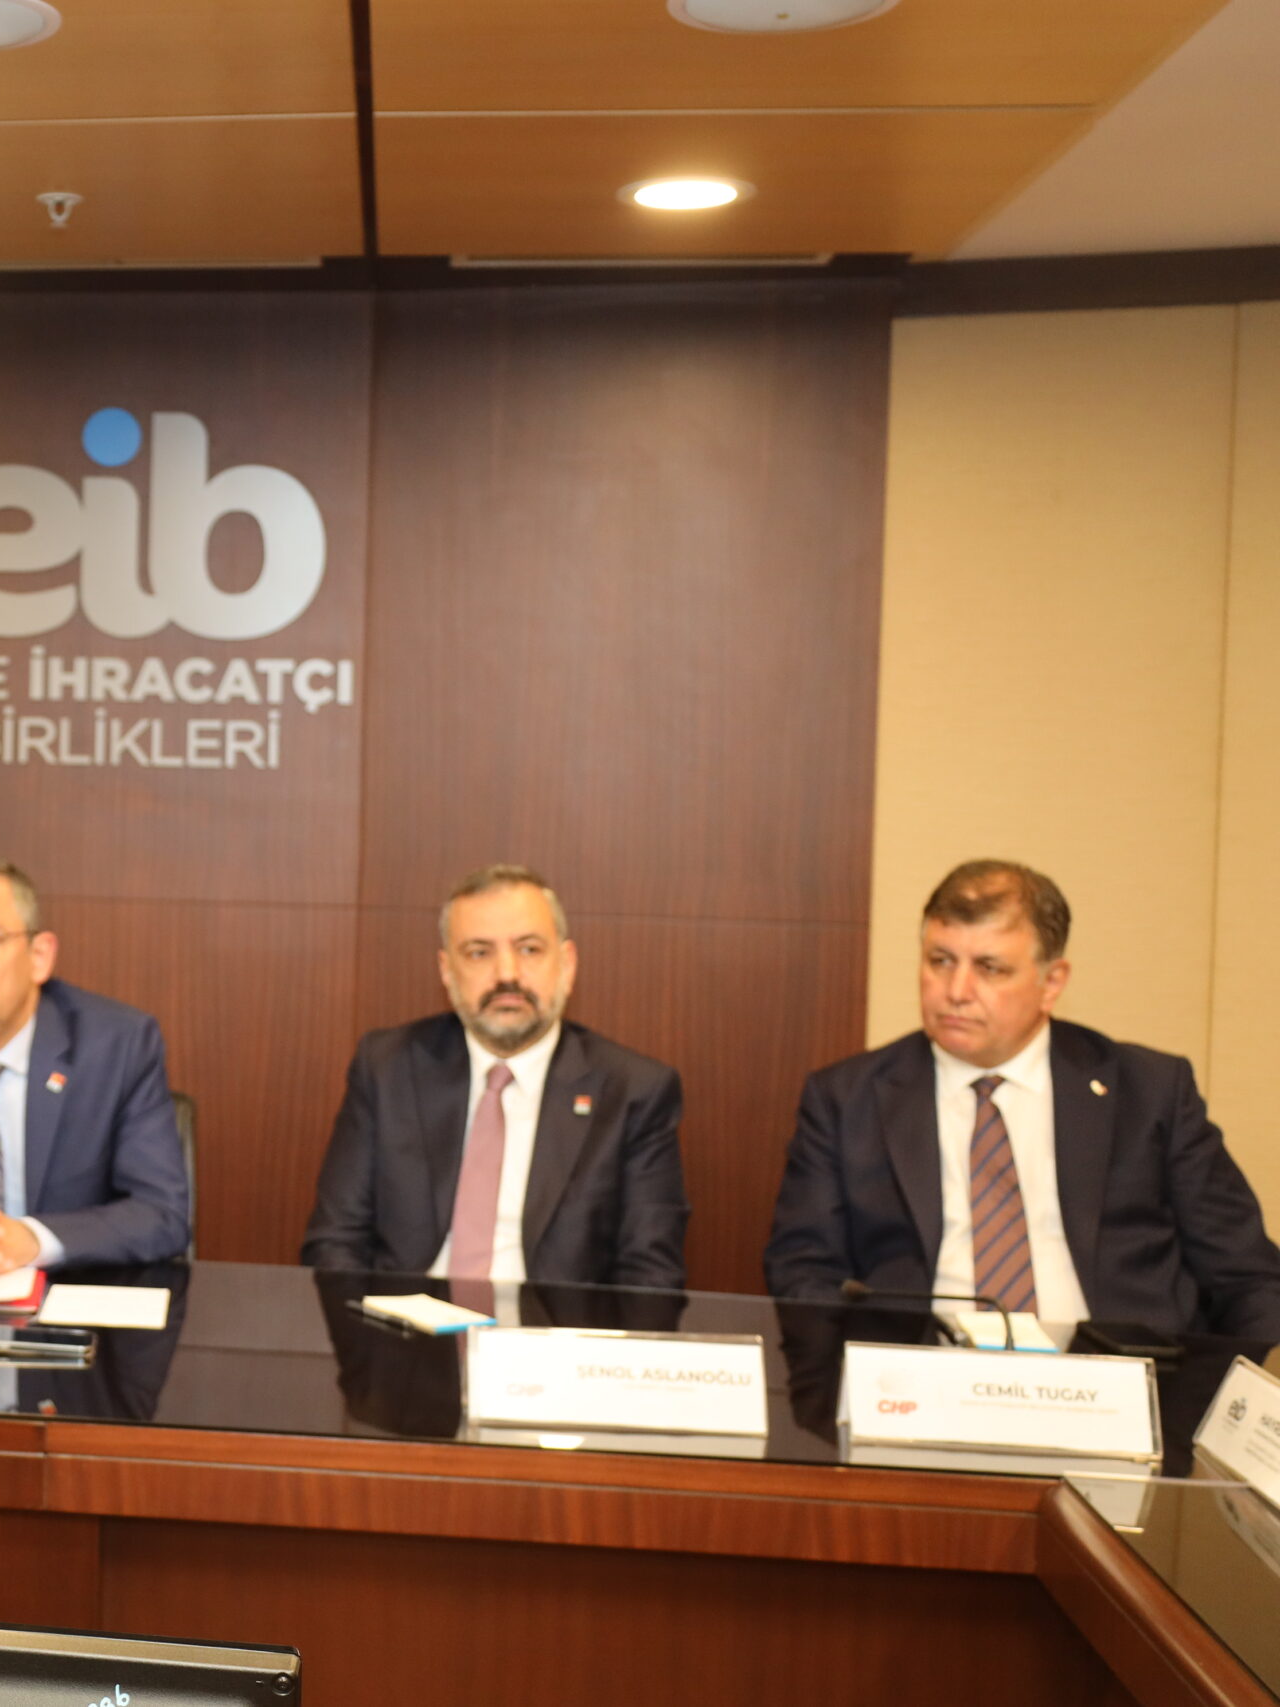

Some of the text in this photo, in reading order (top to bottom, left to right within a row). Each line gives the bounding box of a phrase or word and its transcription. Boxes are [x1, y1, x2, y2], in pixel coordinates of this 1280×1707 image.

[28, 645, 354, 713] İHRACATÇI
[972, 1380, 1099, 1403] CEMİL TUGAY
[877, 1399, 918, 1415] CHP
